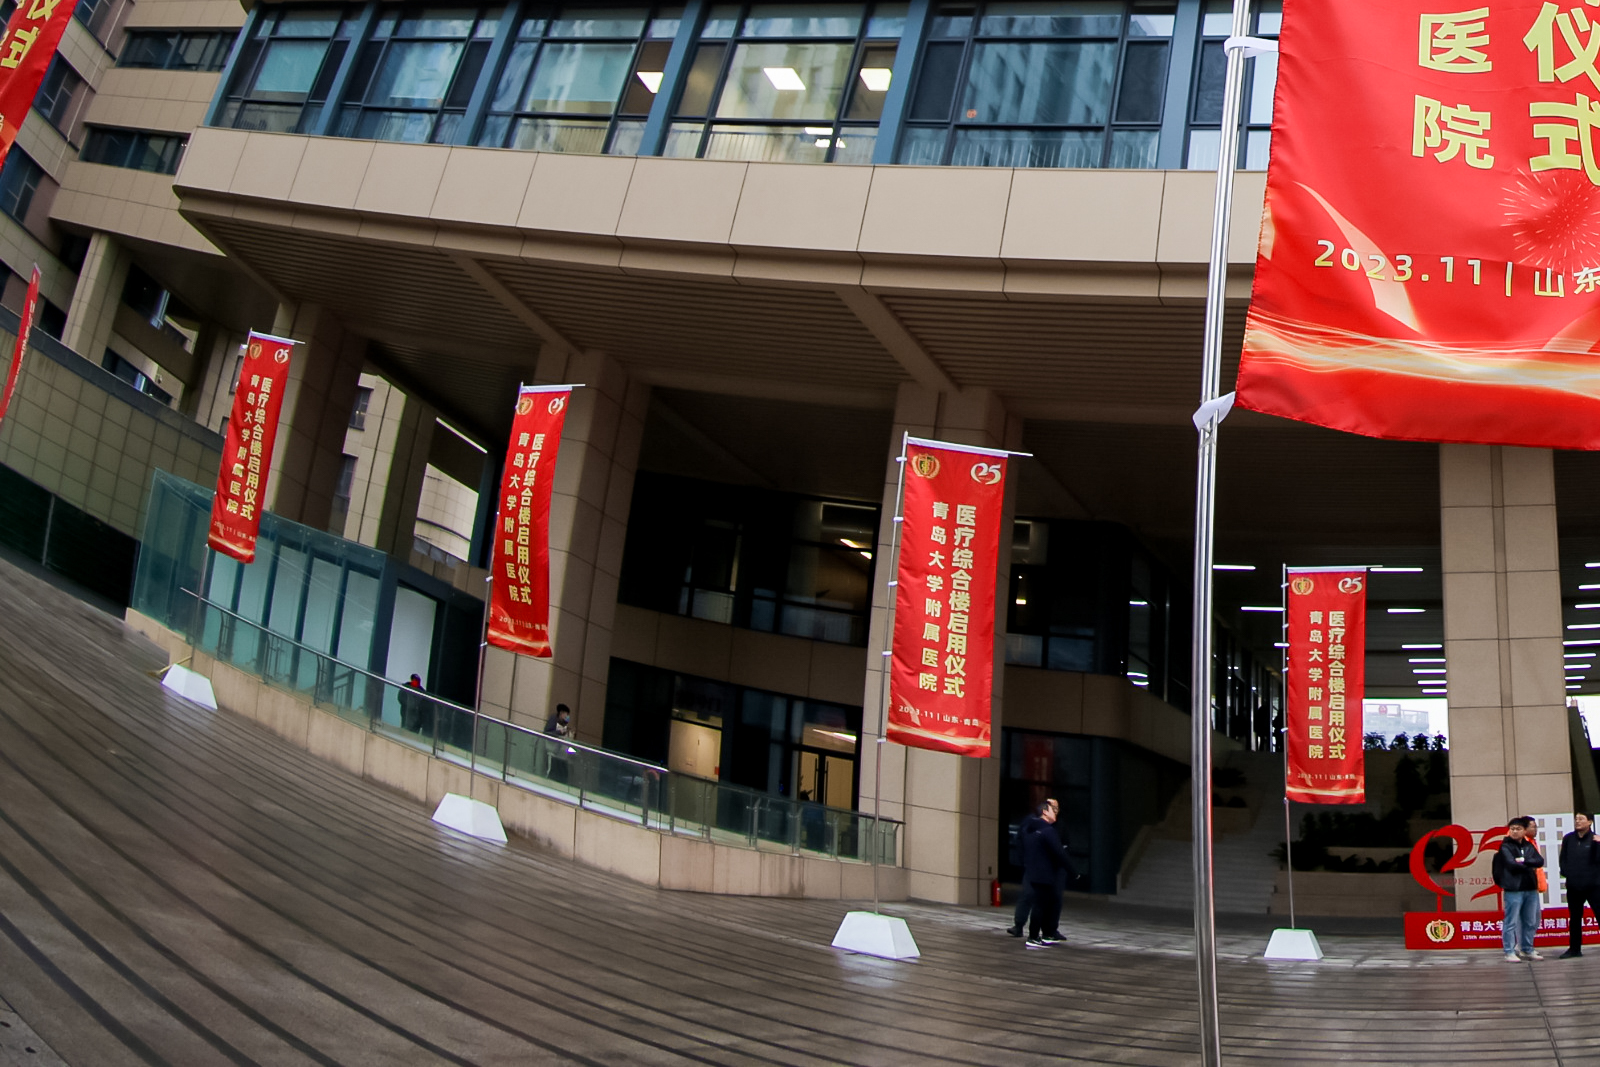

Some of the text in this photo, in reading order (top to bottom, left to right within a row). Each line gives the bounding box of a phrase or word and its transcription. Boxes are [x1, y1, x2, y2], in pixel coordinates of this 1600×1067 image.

[1313, 238, 1484, 287] 2023.11
[226, 374, 260, 514] 青岛大学附属医院
[240, 377, 273, 521] 医疗综合楼启用仪式
[504, 431, 530, 603] 青岛大学附属医院
[516, 433, 545, 605] 医疗综合楼启用仪式
[918, 501, 949, 692] 青岛大学附属医院
[943, 504, 977, 698] 医疗综合楼启用仪式
[1308, 610, 1324, 759] 青岛大学附属医院
[1328, 610, 1346, 760] 医疗综合楼启用仪式
